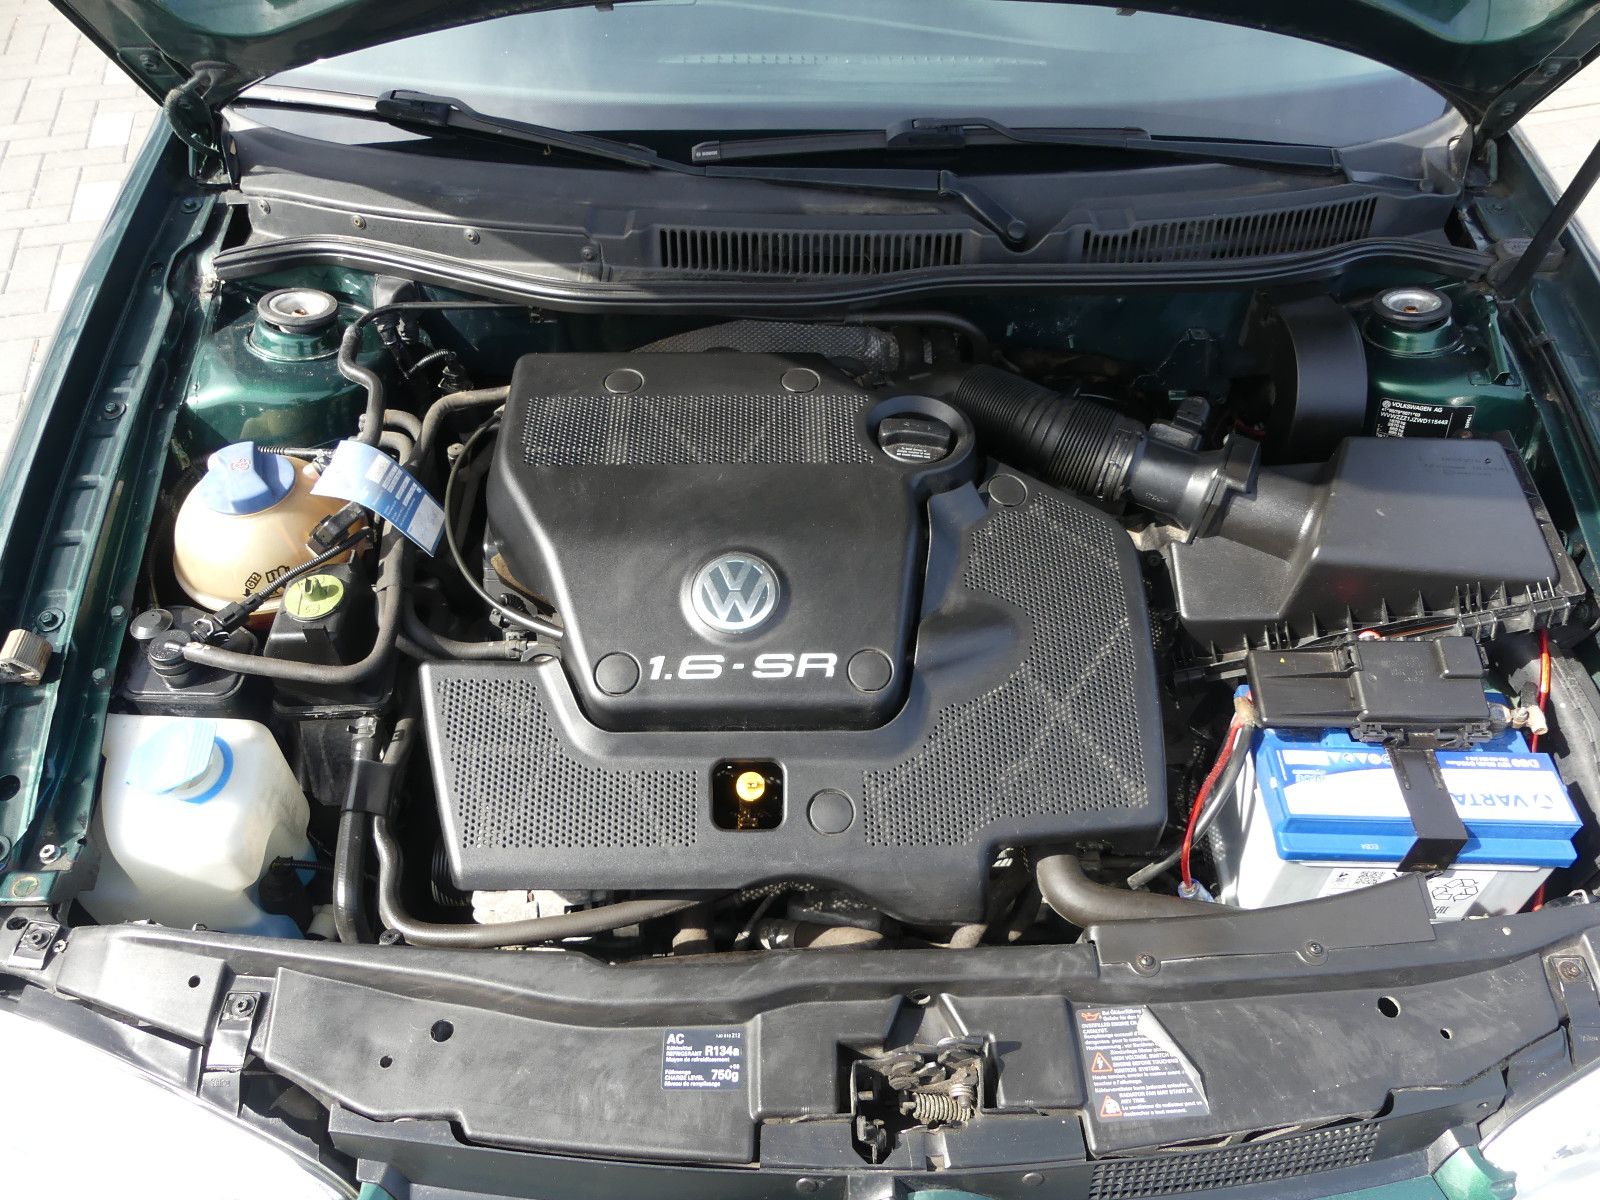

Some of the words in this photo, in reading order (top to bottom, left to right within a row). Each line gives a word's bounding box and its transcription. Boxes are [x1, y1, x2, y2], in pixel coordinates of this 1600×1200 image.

[1391, 402, 1432, 412] VOLKSWAGEN
[1450, 793, 1528, 807] VARTA
[666, 1033, 685, 1045] AC
[704, 1045, 740, 1057] R134a
[711, 1069, 739, 1083] 750g
